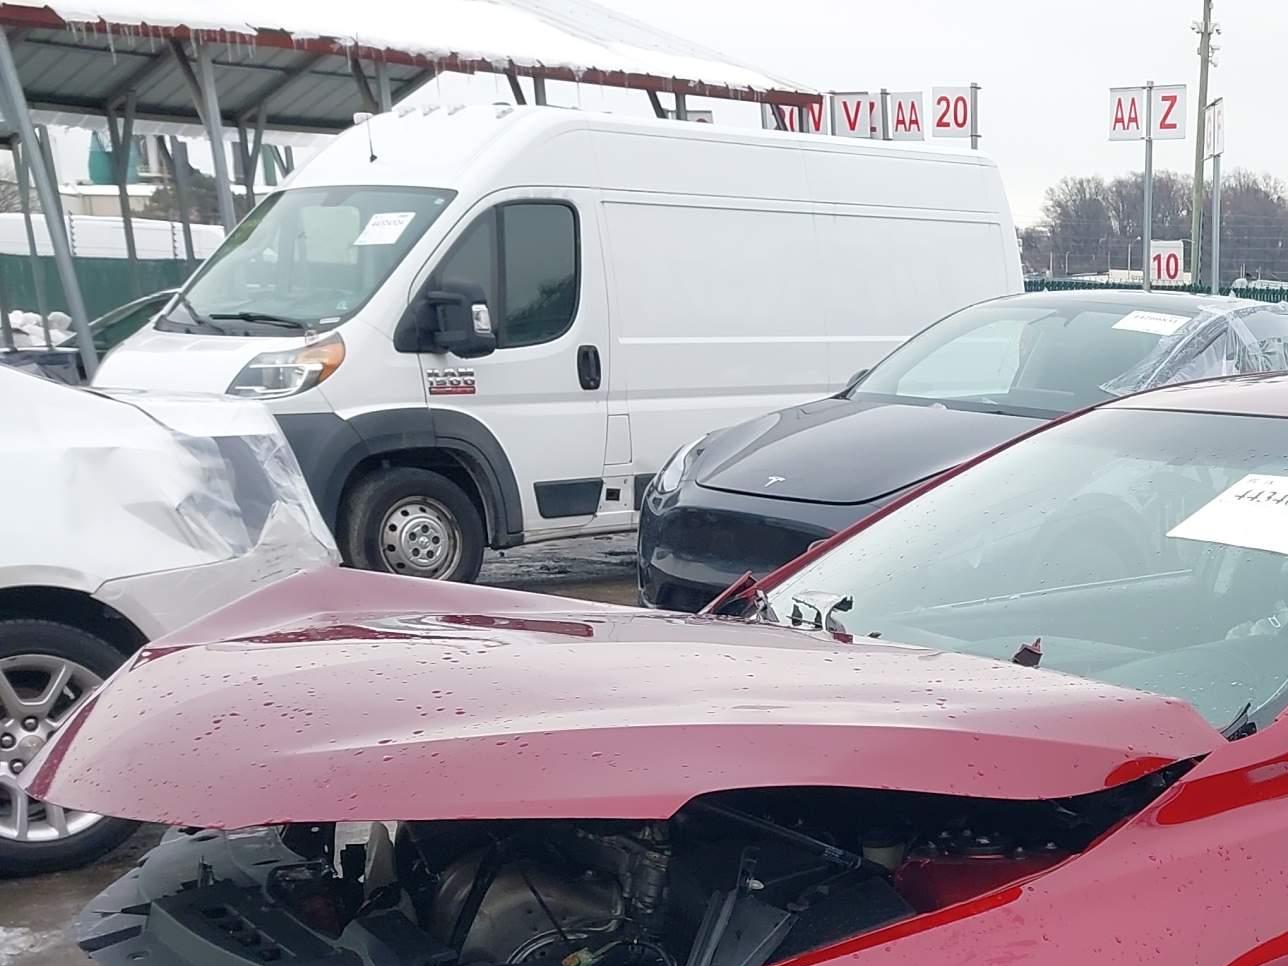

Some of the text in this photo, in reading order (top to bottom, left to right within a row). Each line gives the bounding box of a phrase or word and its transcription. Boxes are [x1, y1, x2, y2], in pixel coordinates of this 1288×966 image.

[842, 101, 862, 131] V
[895, 101, 921, 132] AA
[936, 96, 968, 128] 20
[1113, 97, 1140, 131] AA
[1159, 95, 1178, 129] Z
[1152, 253, 1179, 280] 10
